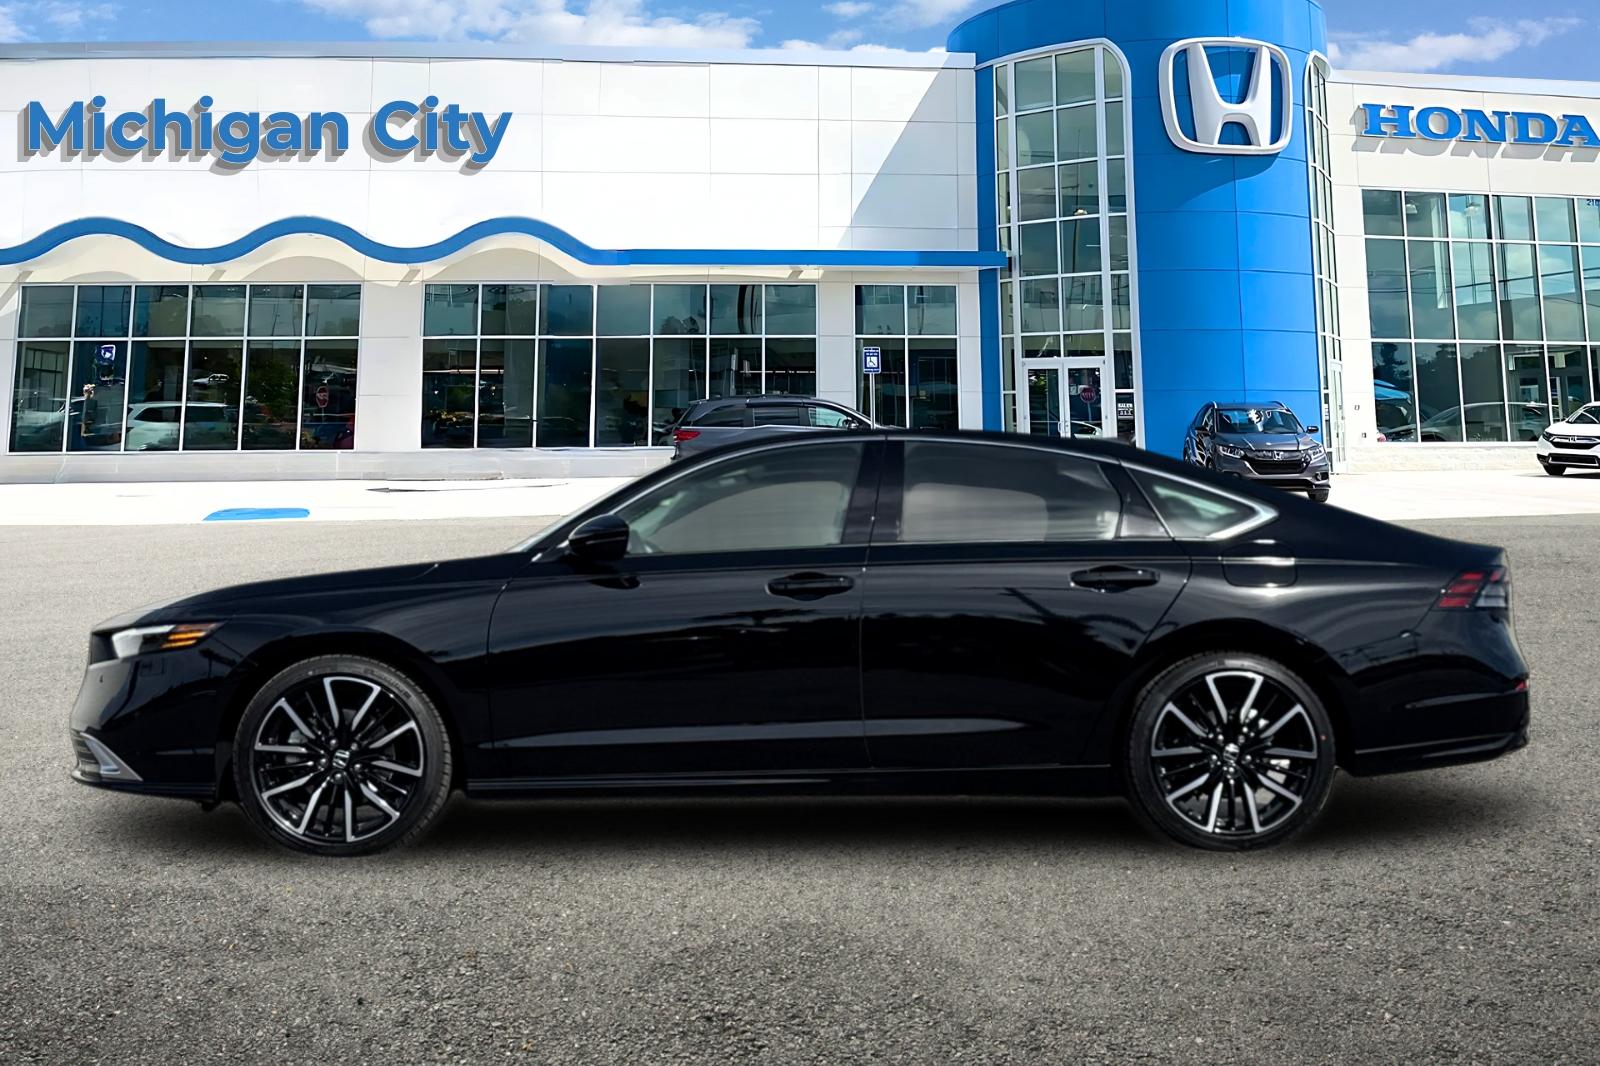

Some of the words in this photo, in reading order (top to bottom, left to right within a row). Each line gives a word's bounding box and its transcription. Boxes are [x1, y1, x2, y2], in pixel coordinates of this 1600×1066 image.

[27, 95, 349, 163] Michigan
[374, 95, 513, 164] City
[1361, 103, 1600, 148] HONDA
